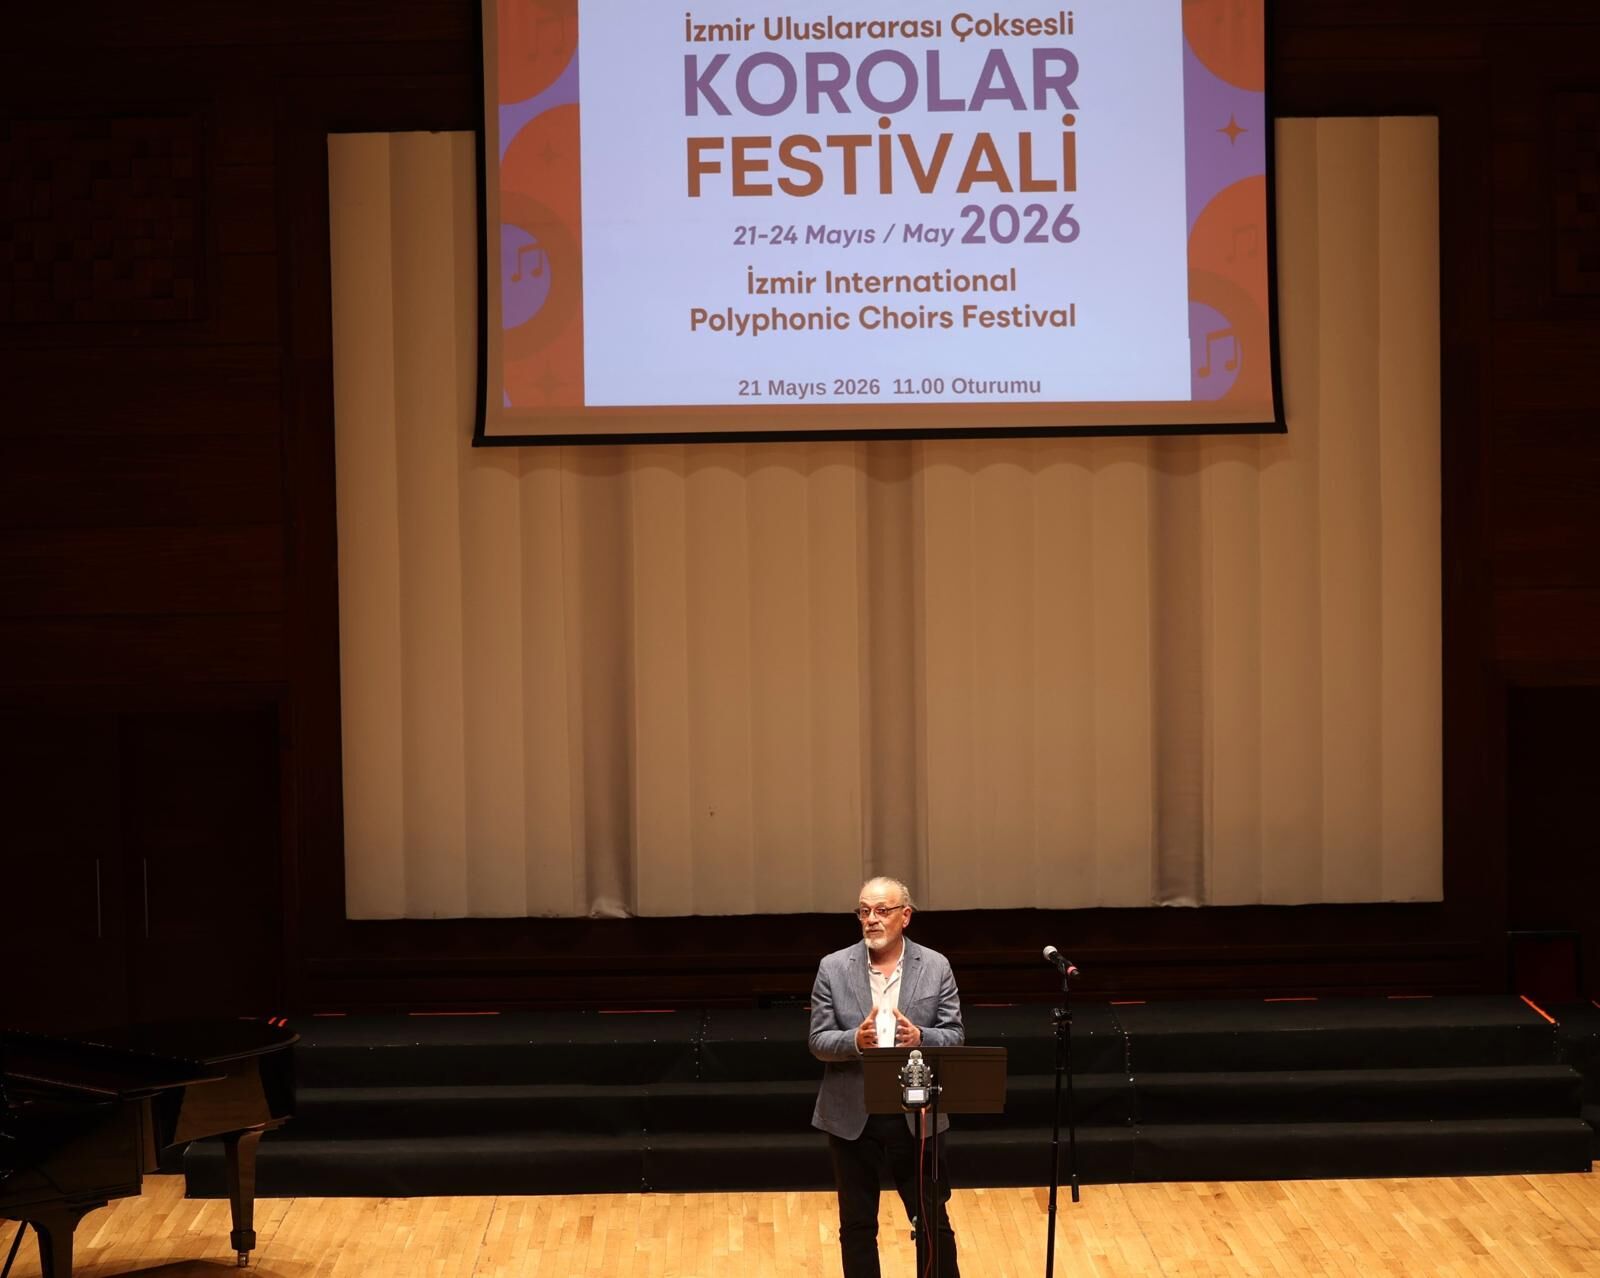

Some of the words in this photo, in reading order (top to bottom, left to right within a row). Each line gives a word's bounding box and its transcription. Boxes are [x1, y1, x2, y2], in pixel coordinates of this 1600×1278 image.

[685, 12, 756, 43] İzmir
[763, 14, 942, 42] Uluslararası
[950, 11, 1074, 43] Çoksesli
[684, 48, 1081, 117] KOROLAR
[686, 113, 1077, 198] FESTİVALİ
[805, 224, 876, 249] Mayıs
[902, 223, 955, 248] May
[959, 203, 1081, 245] 2026
[747, 264, 817, 295] İzmir
[825, 267, 1016, 294] International
[690, 306, 850, 337] Polyphonic
[858, 304, 954, 330] Choirs
[962, 302, 1076, 328] Festival
[738, 379, 762, 396] 21
[768, 379, 827, 400] Mayıs
[833, 378, 881, 396] 2026
[893, 377, 945, 395] 11.00
[951, 377, 1042, 394] Oturumu
